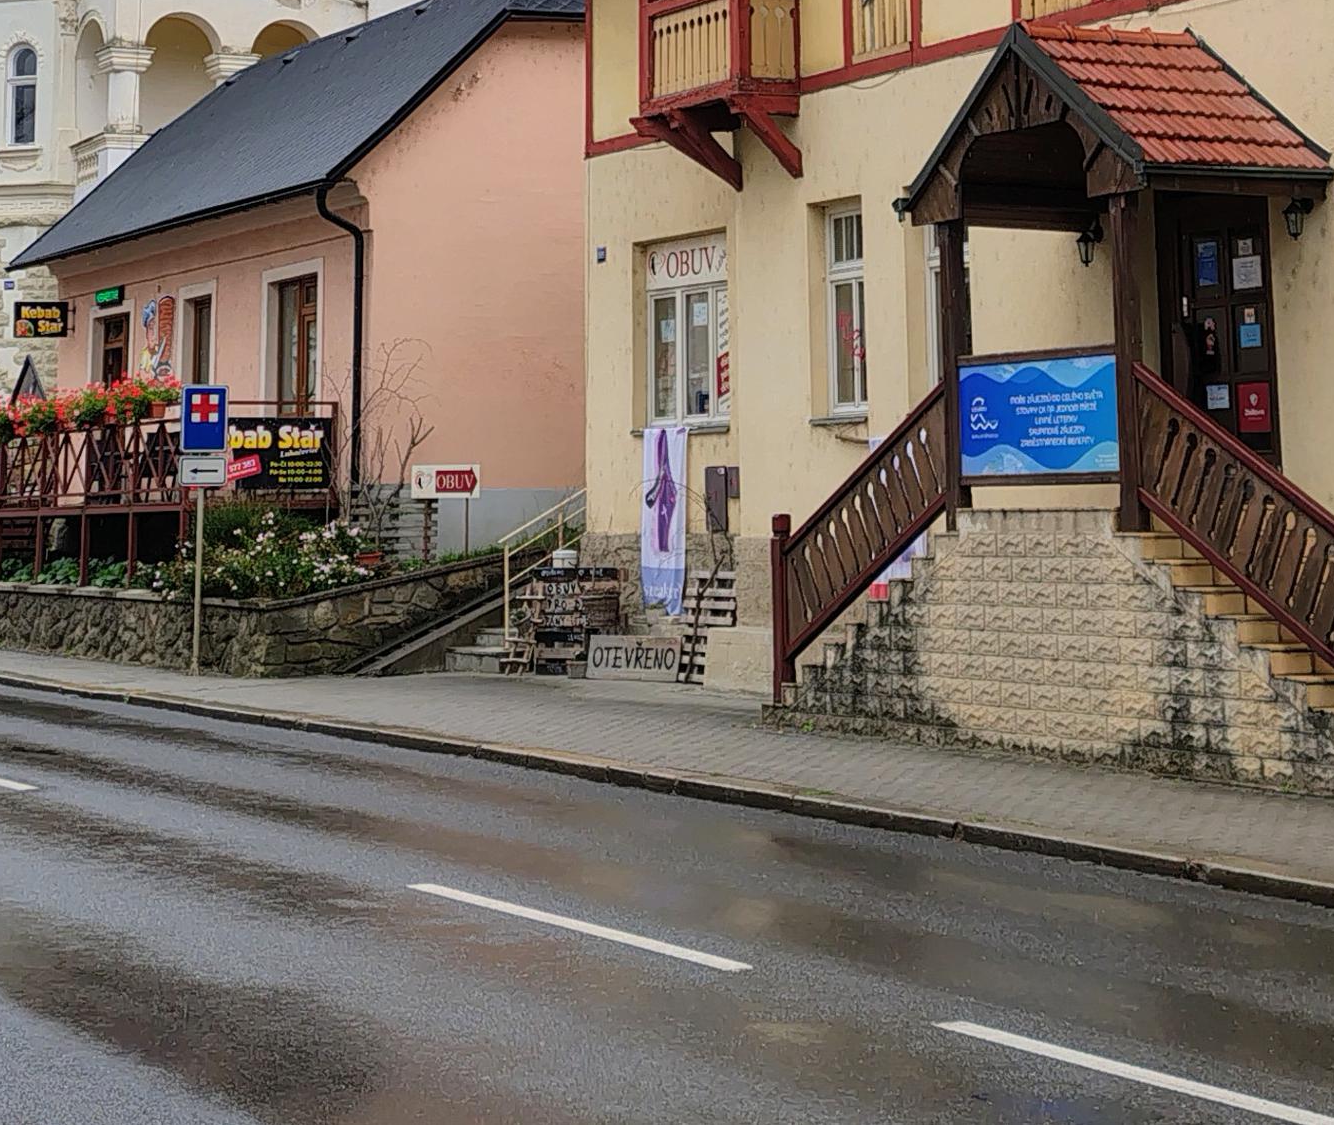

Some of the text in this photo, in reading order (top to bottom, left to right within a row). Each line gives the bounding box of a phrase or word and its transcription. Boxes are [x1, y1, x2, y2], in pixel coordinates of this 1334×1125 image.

[666, 245, 716, 279] OBUV
[20, 305, 61, 319] Kebab
[37, 320, 64, 333] Star
[278, 425, 324, 449] Star
[436, 473, 474, 489] OBUV
[592, 640, 676, 671] OTEVŘENO
